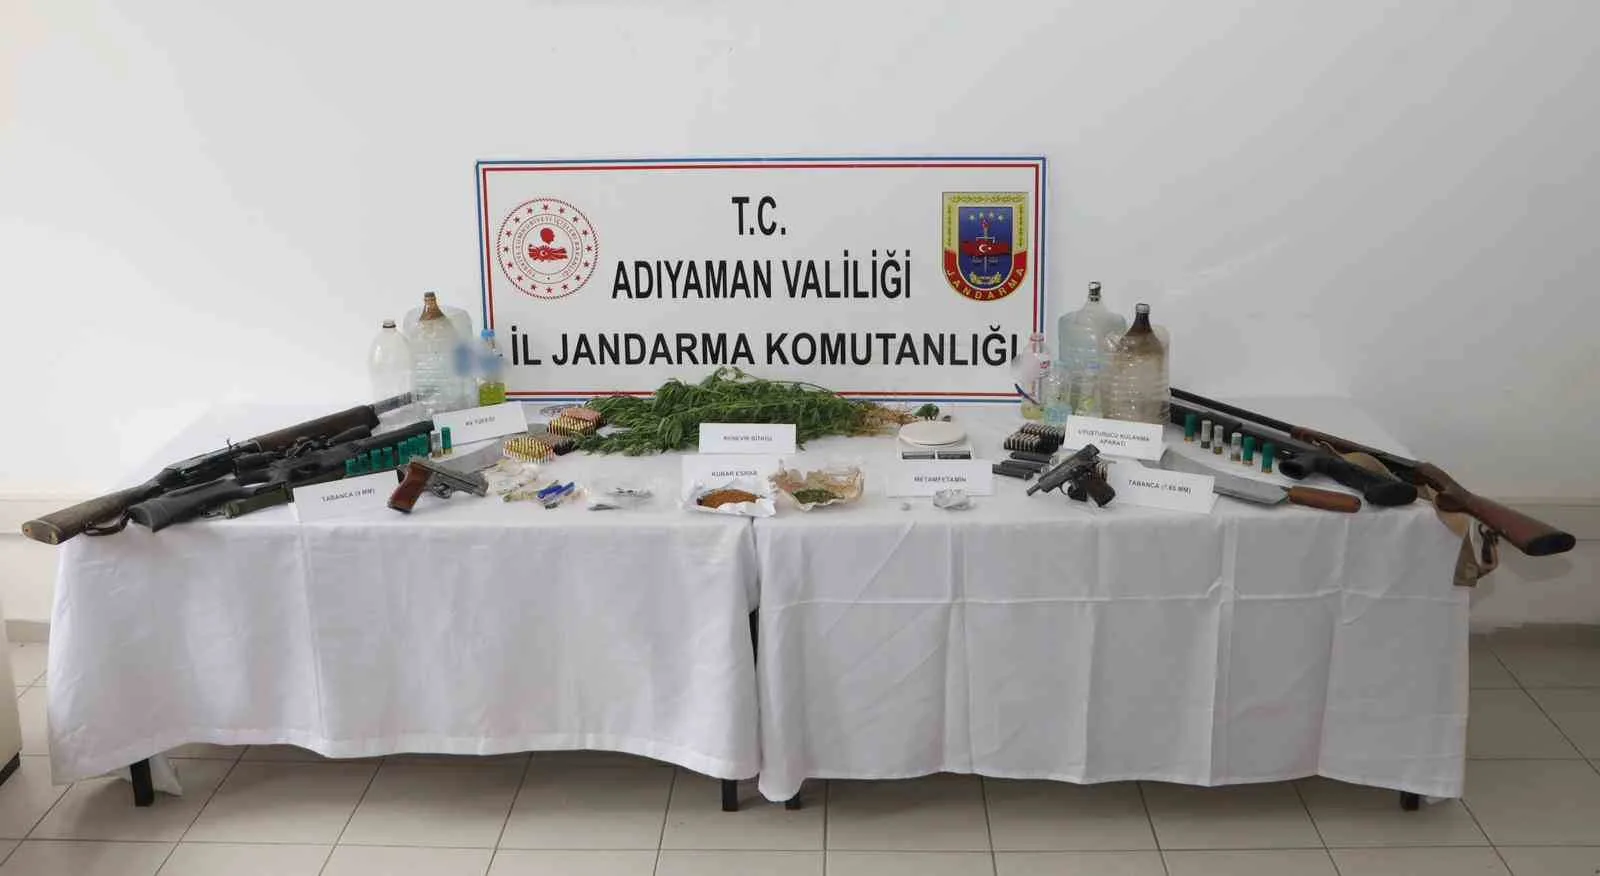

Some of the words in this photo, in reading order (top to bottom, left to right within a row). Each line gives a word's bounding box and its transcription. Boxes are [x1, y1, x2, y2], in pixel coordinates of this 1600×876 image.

[732, 197, 786, 236] T.C.
[612, 260, 774, 299] ADIYAMAN
[782, 250, 911, 299] VALİLİĞİ
[511, 326, 542, 366] İL
[552, 333, 755, 366] JANDARMA
